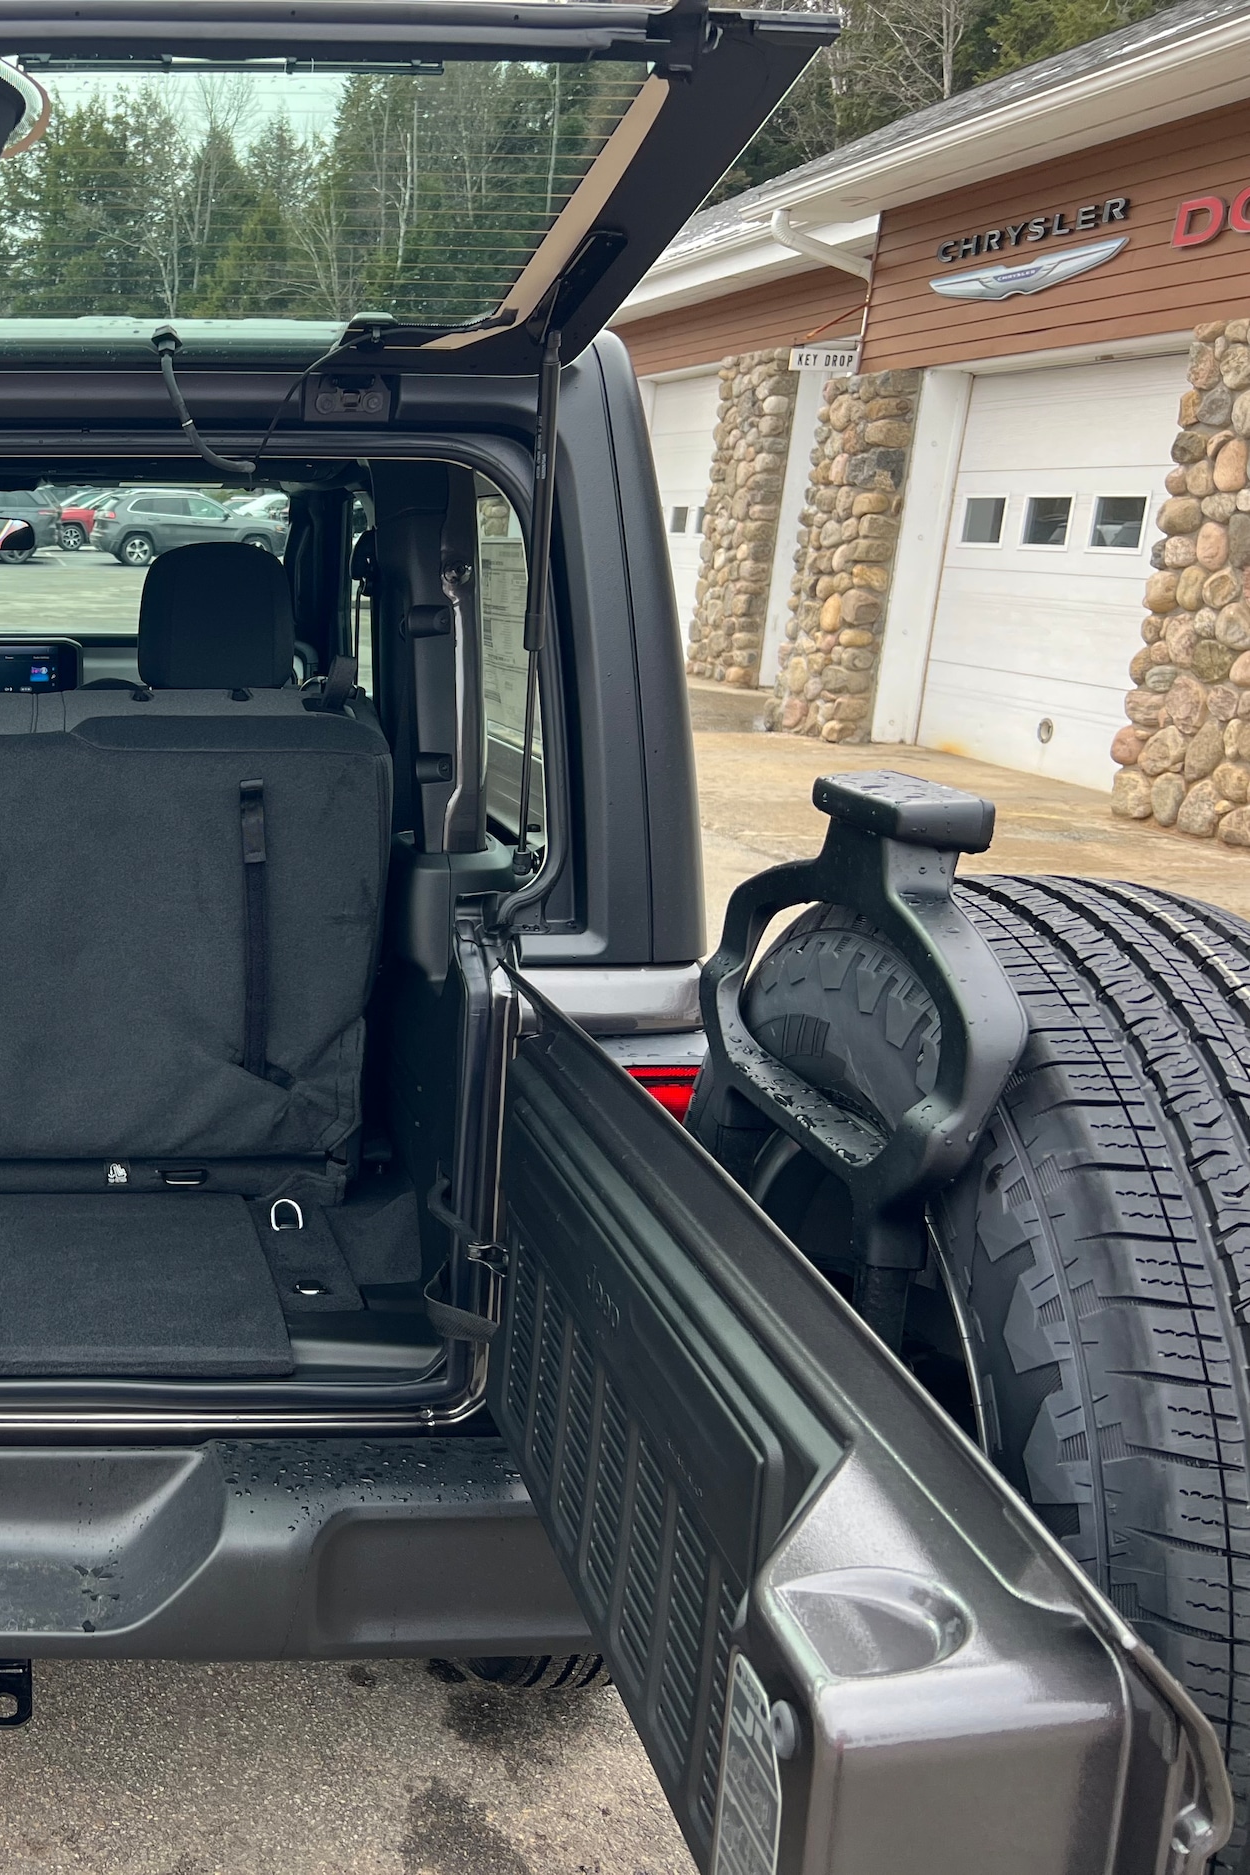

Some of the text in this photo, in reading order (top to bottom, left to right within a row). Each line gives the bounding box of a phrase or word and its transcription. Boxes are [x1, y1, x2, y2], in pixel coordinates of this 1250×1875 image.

[937, 197, 1130, 263] CHRYSLER
[797, 353, 854, 367] KEY DROP
